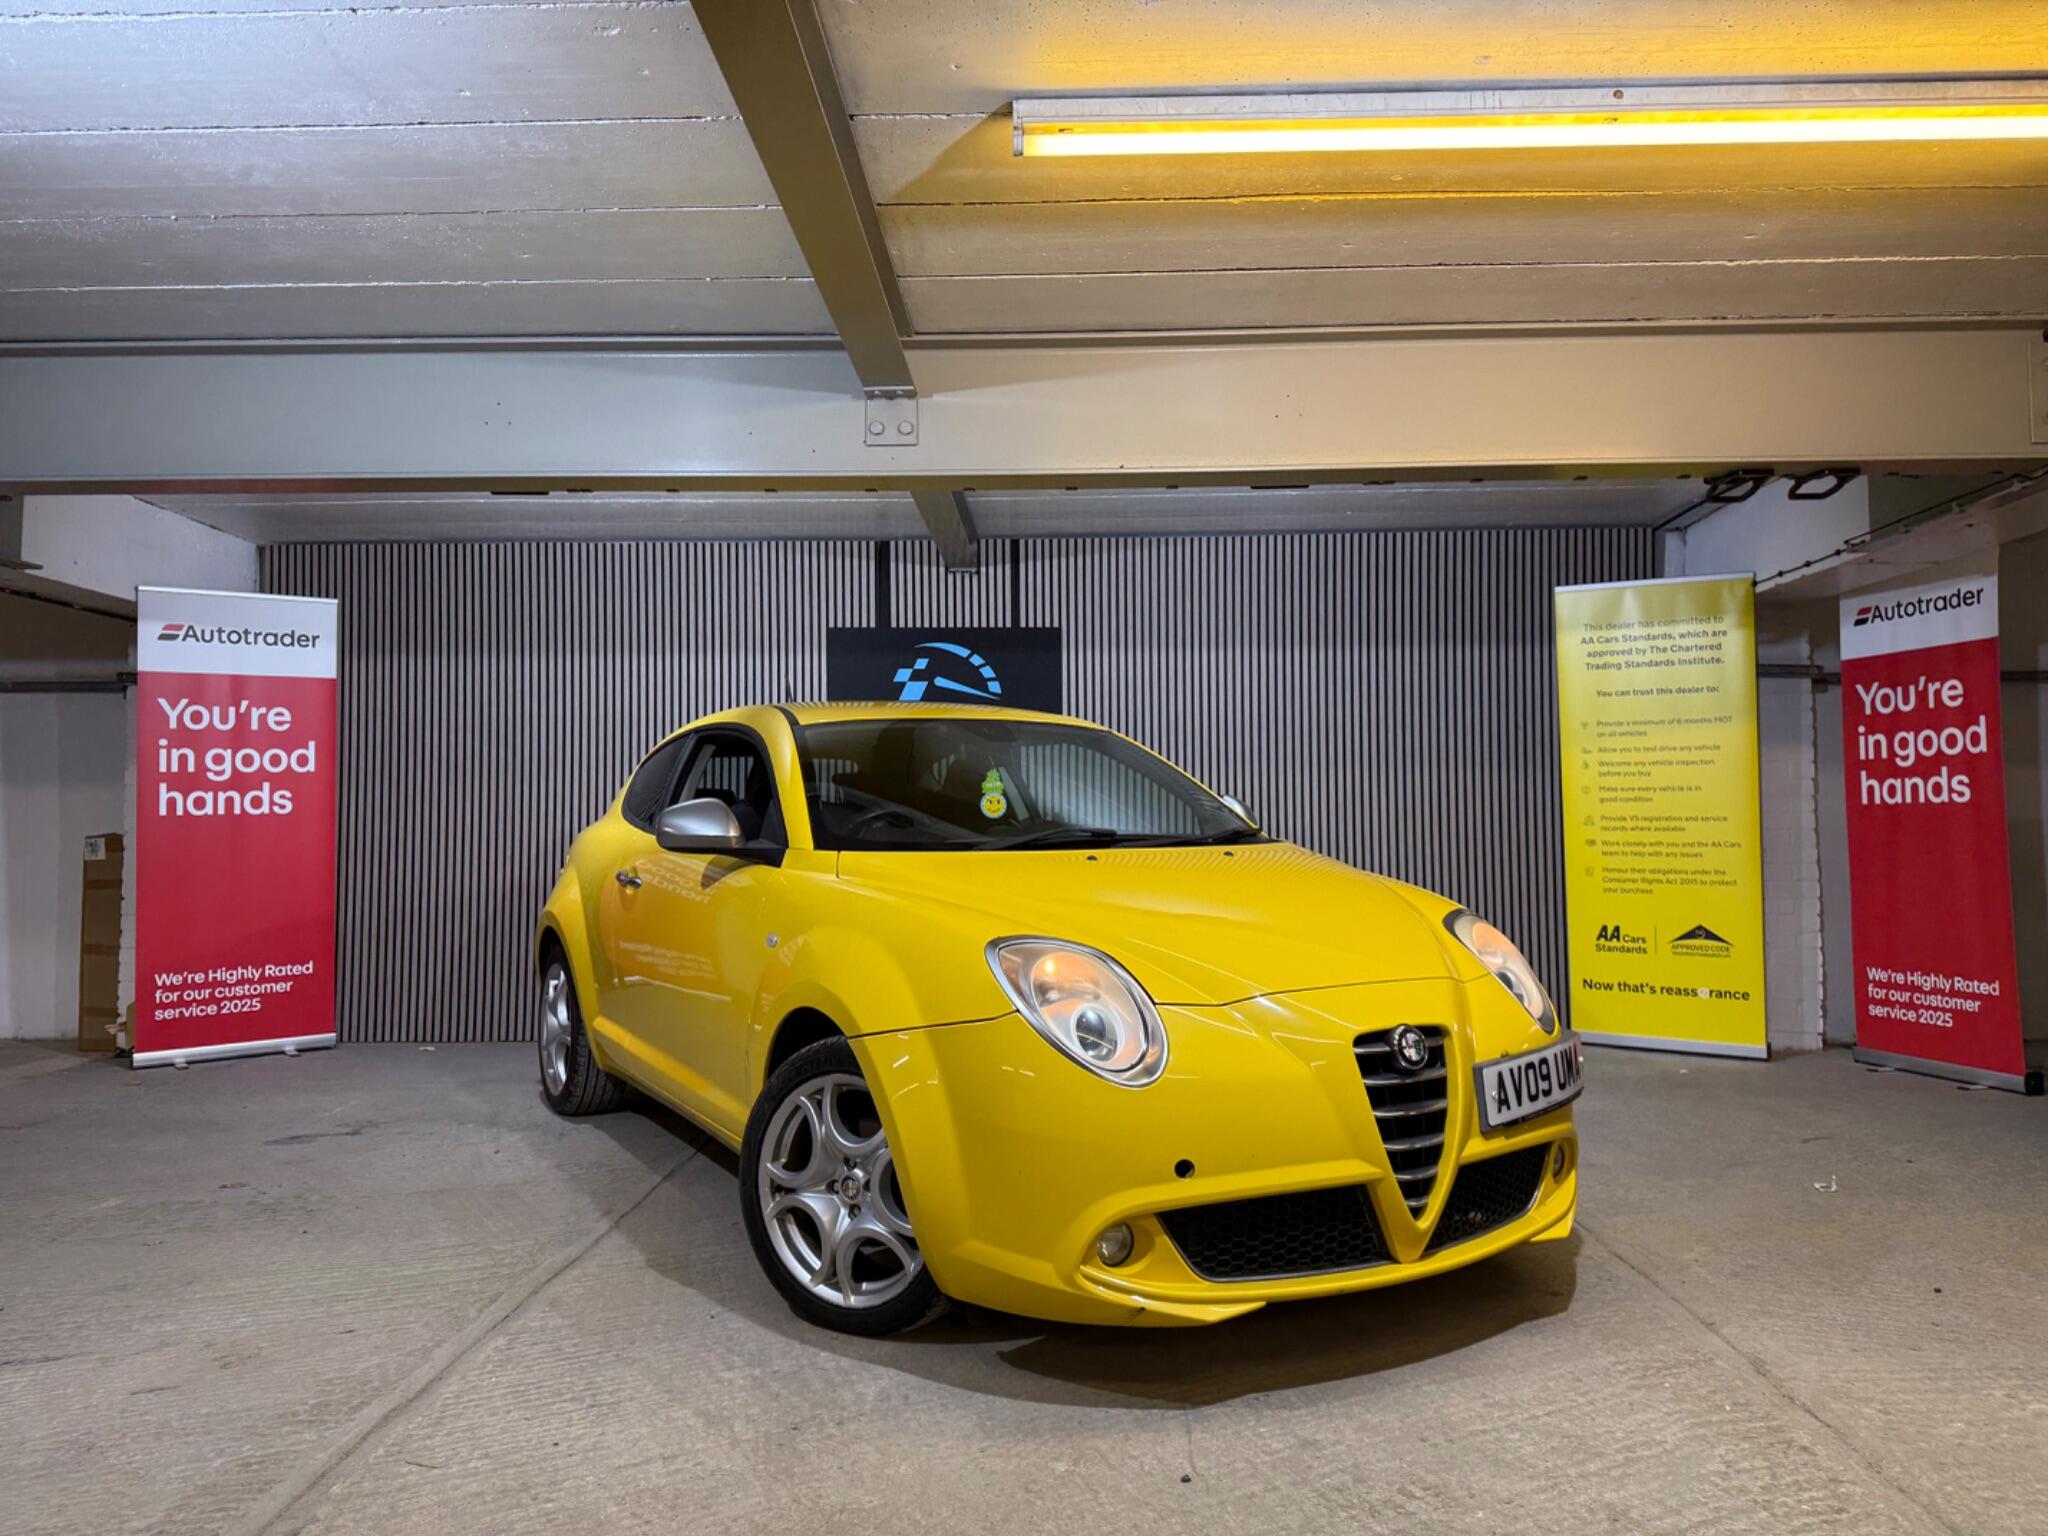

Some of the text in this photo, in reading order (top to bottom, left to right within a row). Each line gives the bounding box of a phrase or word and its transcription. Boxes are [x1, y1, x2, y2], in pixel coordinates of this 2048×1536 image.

[1871, 587, 1983, 623] Autotrader
[1584, 615, 1724, 632] This dealer has committed to
[182, 625, 320, 648] Autotrader
[1581, 629, 1727, 645] AA Cars Standards, which are
[1587, 642, 1722, 658] approved by The Chartered
[1585, 656, 1724, 671] Trading Standards Institute.
[1633, 688, 1654, 696] trust
[1656, 687, 1673, 695] this
[1675, 686, 1704, 694] dealer
[1856, 676, 1963, 715] You're
[157, 698, 291, 731] You're
[1858, 715, 1987, 767] in good
[159, 739, 315, 781] in good
[1860, 766, 1971, 805] hands
[159, 782, 292, 816] hands
[1622, 840, 1646, 848] closely
[1682, 840, 1695, 848] and
[1696, 840, 1708, 848] the
[1596, 925, 1646, 944] AA Cars
[1596, 943, 1648, 955] Standards
[1672, 944, 1730, 953] APPROVED CODE
[155, 960, 313, 986] We're Highly Rated
[1867, 967, 1999, 996] We're Highly Rated
[155, 980, 293, 1004] for our customer
[1582, 978, 1614, 991] Now
[1617, 981, 1656, 994] that's
[155, 998, 261, 1020] service 2025
[1868, 984, 1981, 1012] for our customer
[1868, 1004, 1952, 1027] service 2025
[1497, 1057, 1552, 1114] AV09
